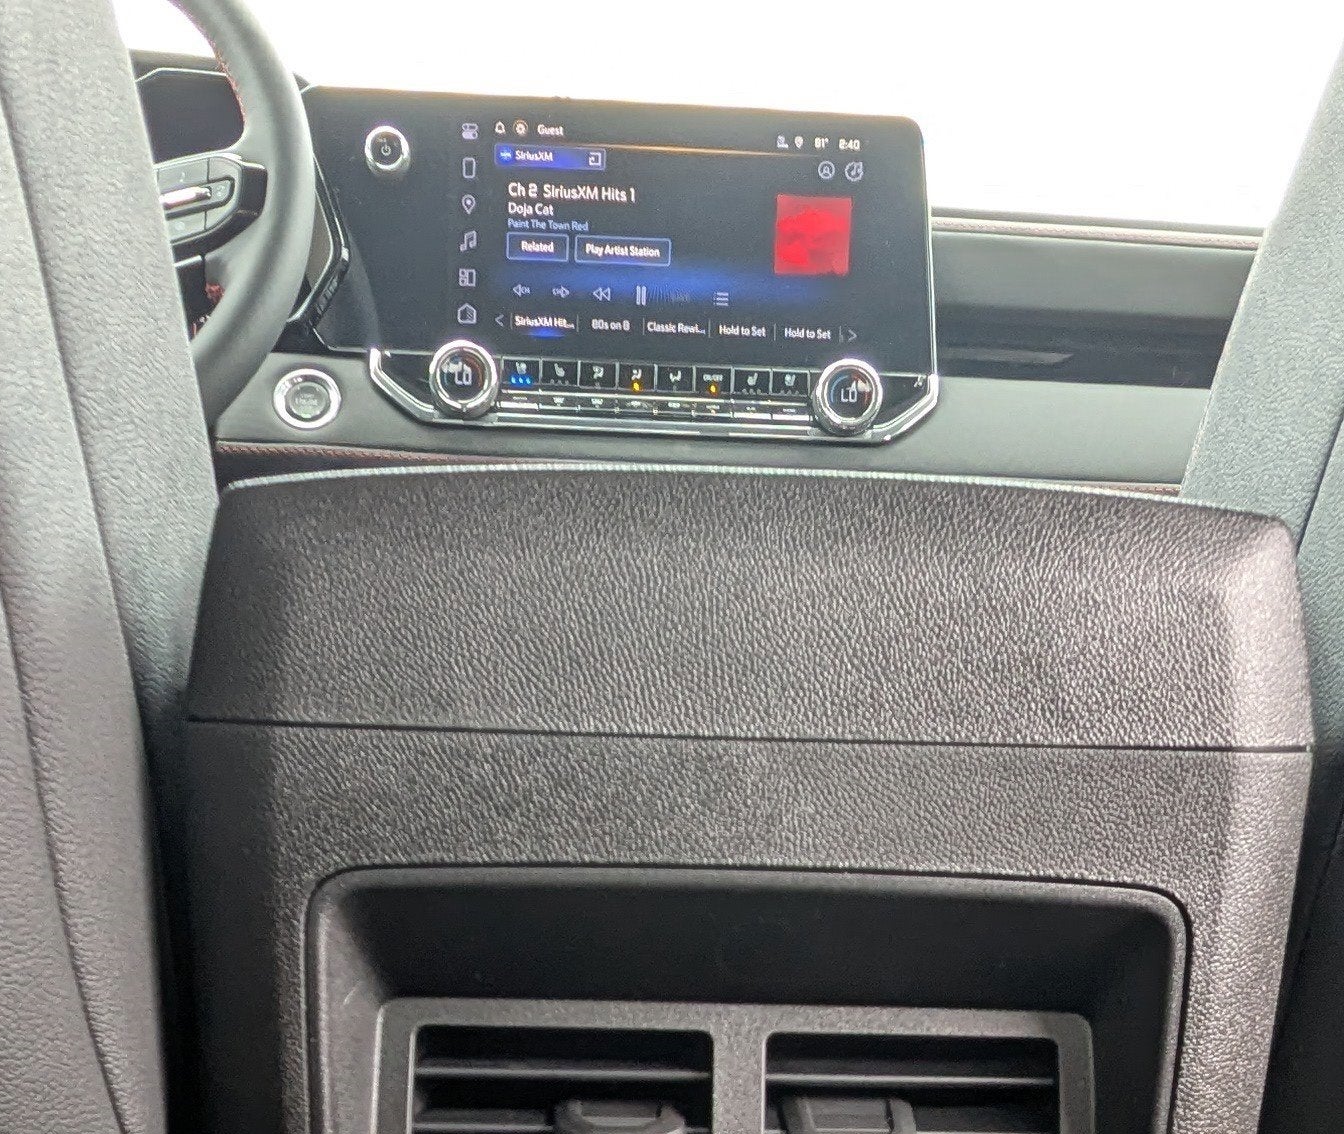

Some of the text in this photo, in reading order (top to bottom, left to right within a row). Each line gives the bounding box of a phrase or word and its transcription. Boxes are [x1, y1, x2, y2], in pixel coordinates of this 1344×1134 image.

[537, 124, 564, 136] Guest
[515, 150, 553, 162] SiriusXM
[508, 182, 636, 203] Ch 2 SiriusXM Hits 1
[508, 202, 554, 217] Doja Cat
[507, 218, 589, 231] Paint The Town Red
[521, 240, 554, 253] Related
[585, 243, 661, 258] Play Artist Station
[610, 321, 622, 330] on
[647, 321, 676, 334] Classic
[718, 324, 766, 337] Hold to Set
[784, 327, 831, 340] Hold to Set
